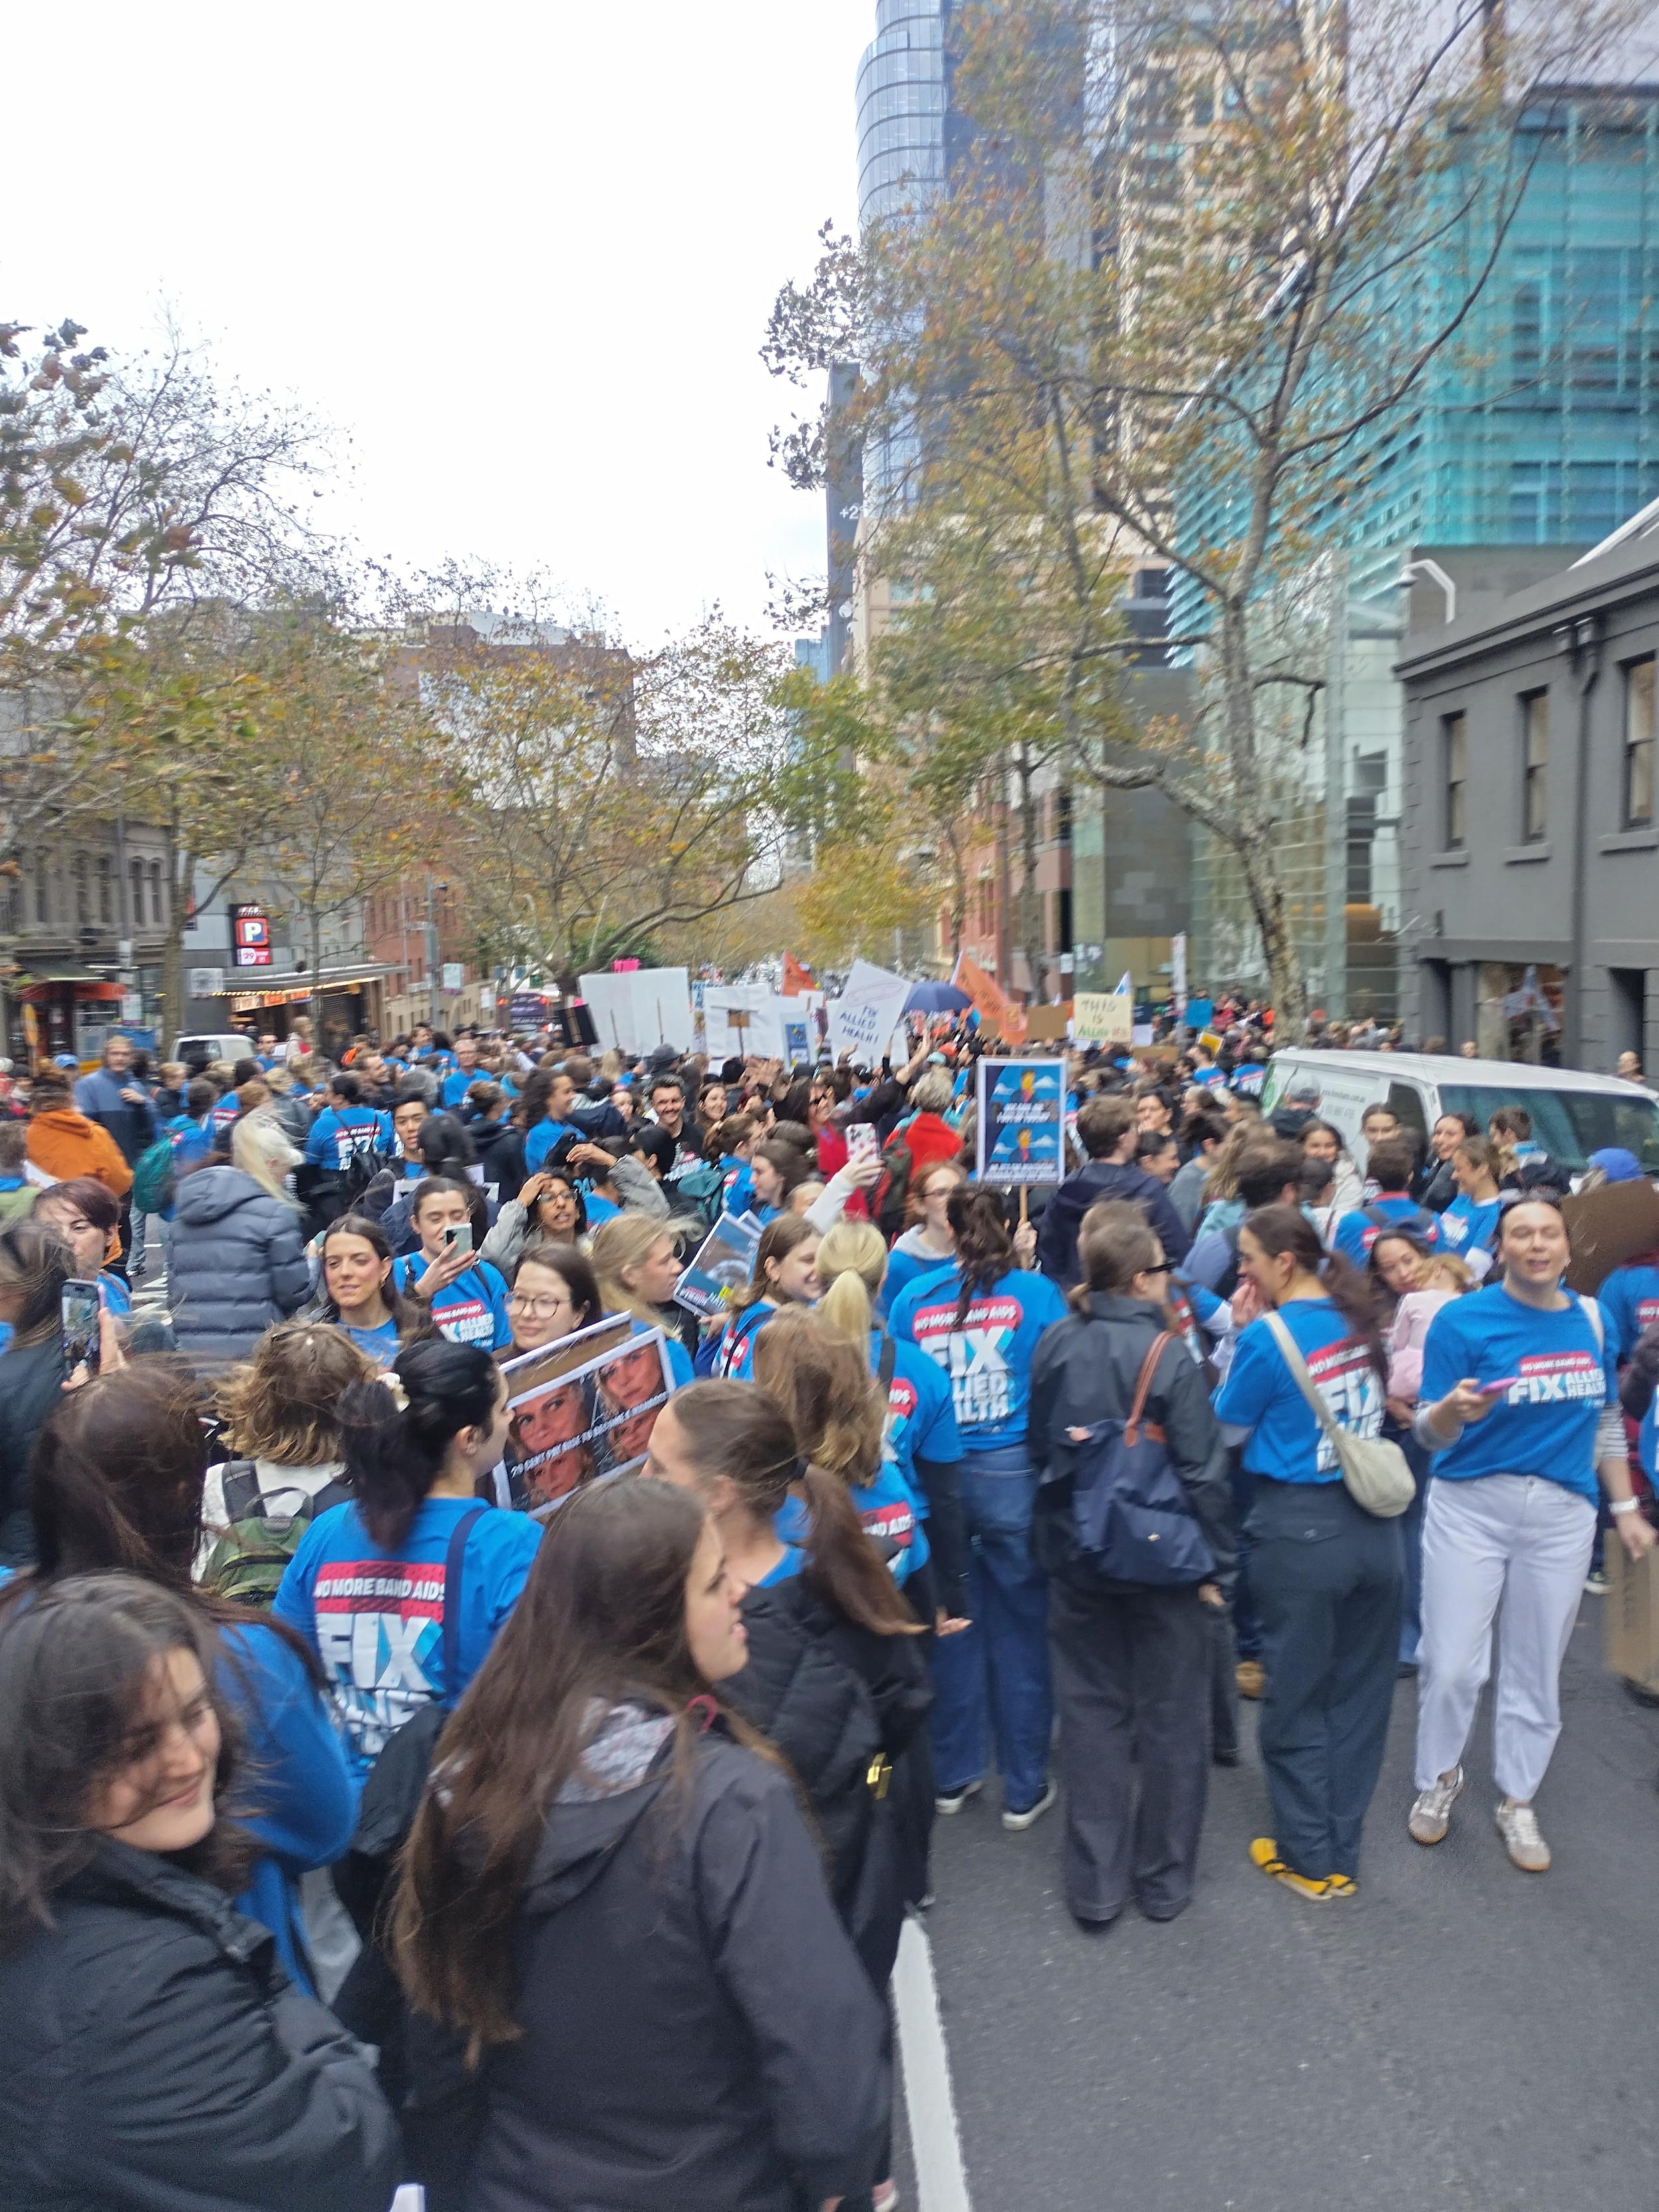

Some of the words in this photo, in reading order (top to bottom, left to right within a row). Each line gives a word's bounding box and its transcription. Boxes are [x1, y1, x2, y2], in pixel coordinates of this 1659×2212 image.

[244, 922, 261, 942] P
[1081, 999, 1118, 1011] THIS
[839, 1011, 876, 1030] ALLIED
[988, 1305, 1016, 1321] AIDS
[1521, 1362, 1533, 1372] NO
[1533, 1360, 1555, 1370] MORE
[1555, 1357, 1575, 1368] BAND
[1509, 1373, 1566, 1406] FIX
[314, 1580, 331, 1598] NO
[331, 1577, 375, 1598] MORE
[375, 1577, 412, 1599] BAND
[315, 1612, 434, 1692] FIX
